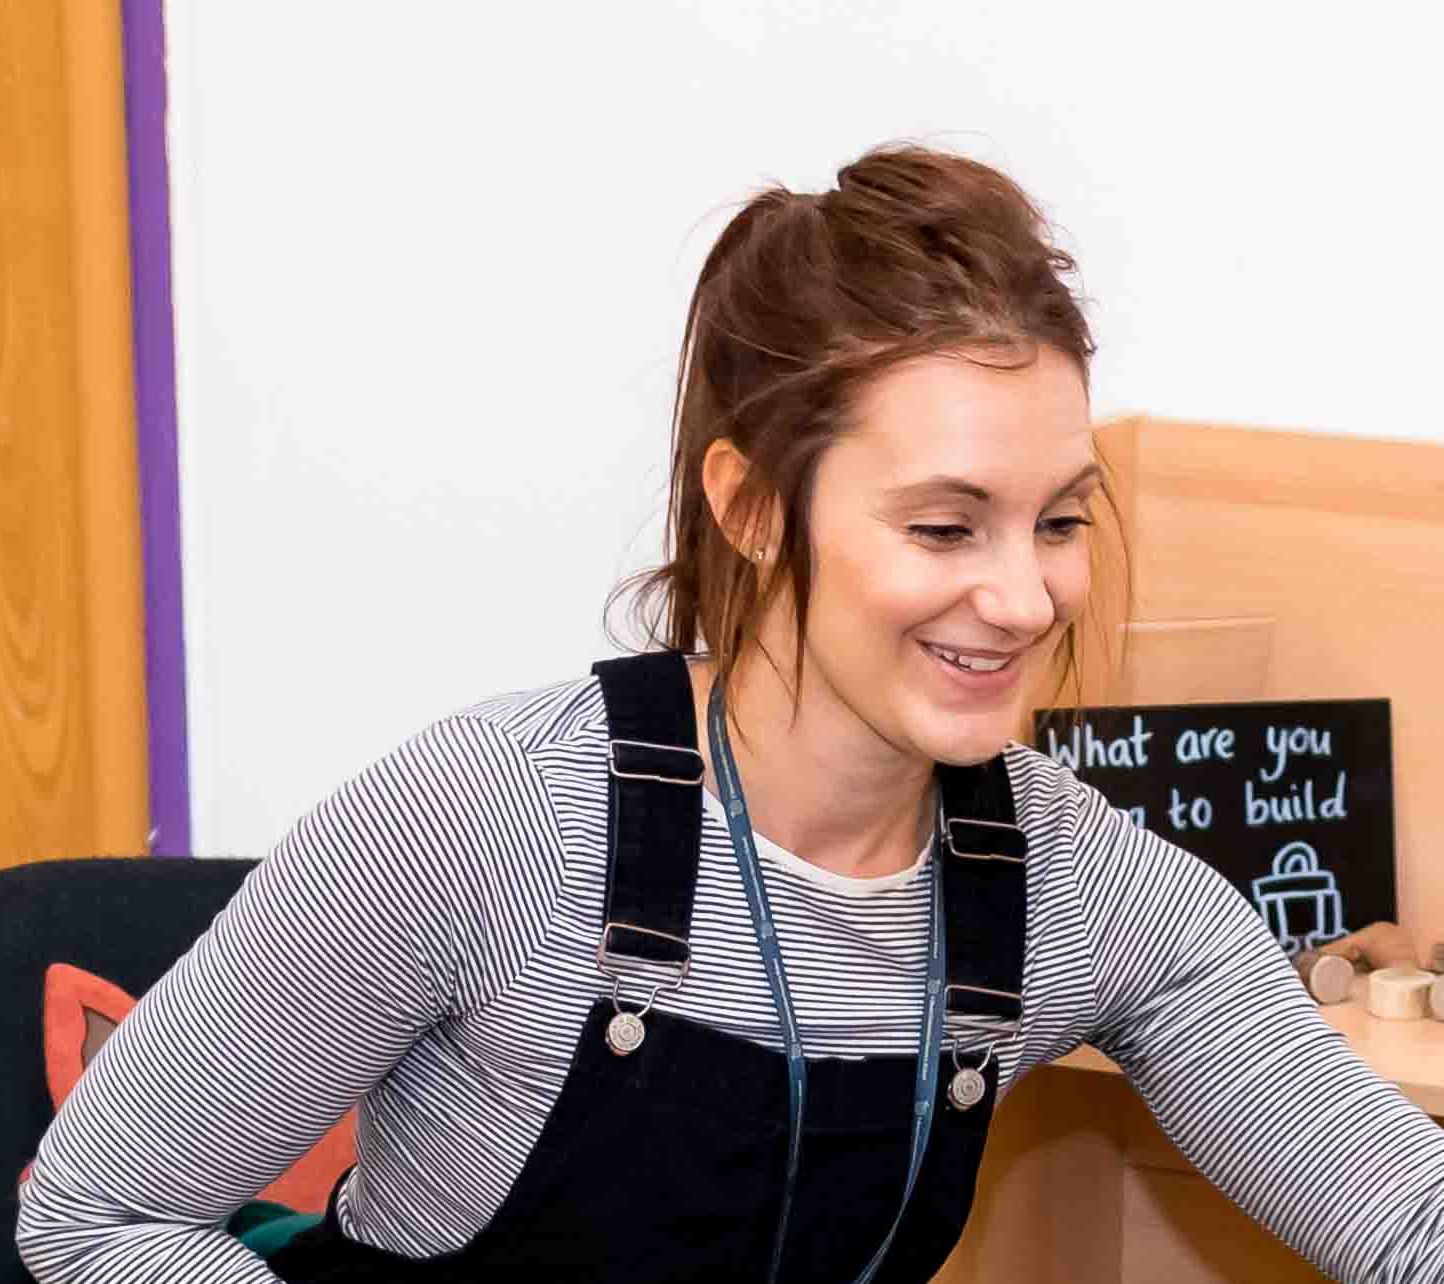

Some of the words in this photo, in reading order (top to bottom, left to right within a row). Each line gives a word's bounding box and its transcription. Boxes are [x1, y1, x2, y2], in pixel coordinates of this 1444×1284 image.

[1048, 715, 1153, 771] What
[1175, 727, 1236, 764] are
[1260, 725, 1332, 782] you
[1168, 788, 1212, 830] to
[1245, 770, 1348, 827] build
